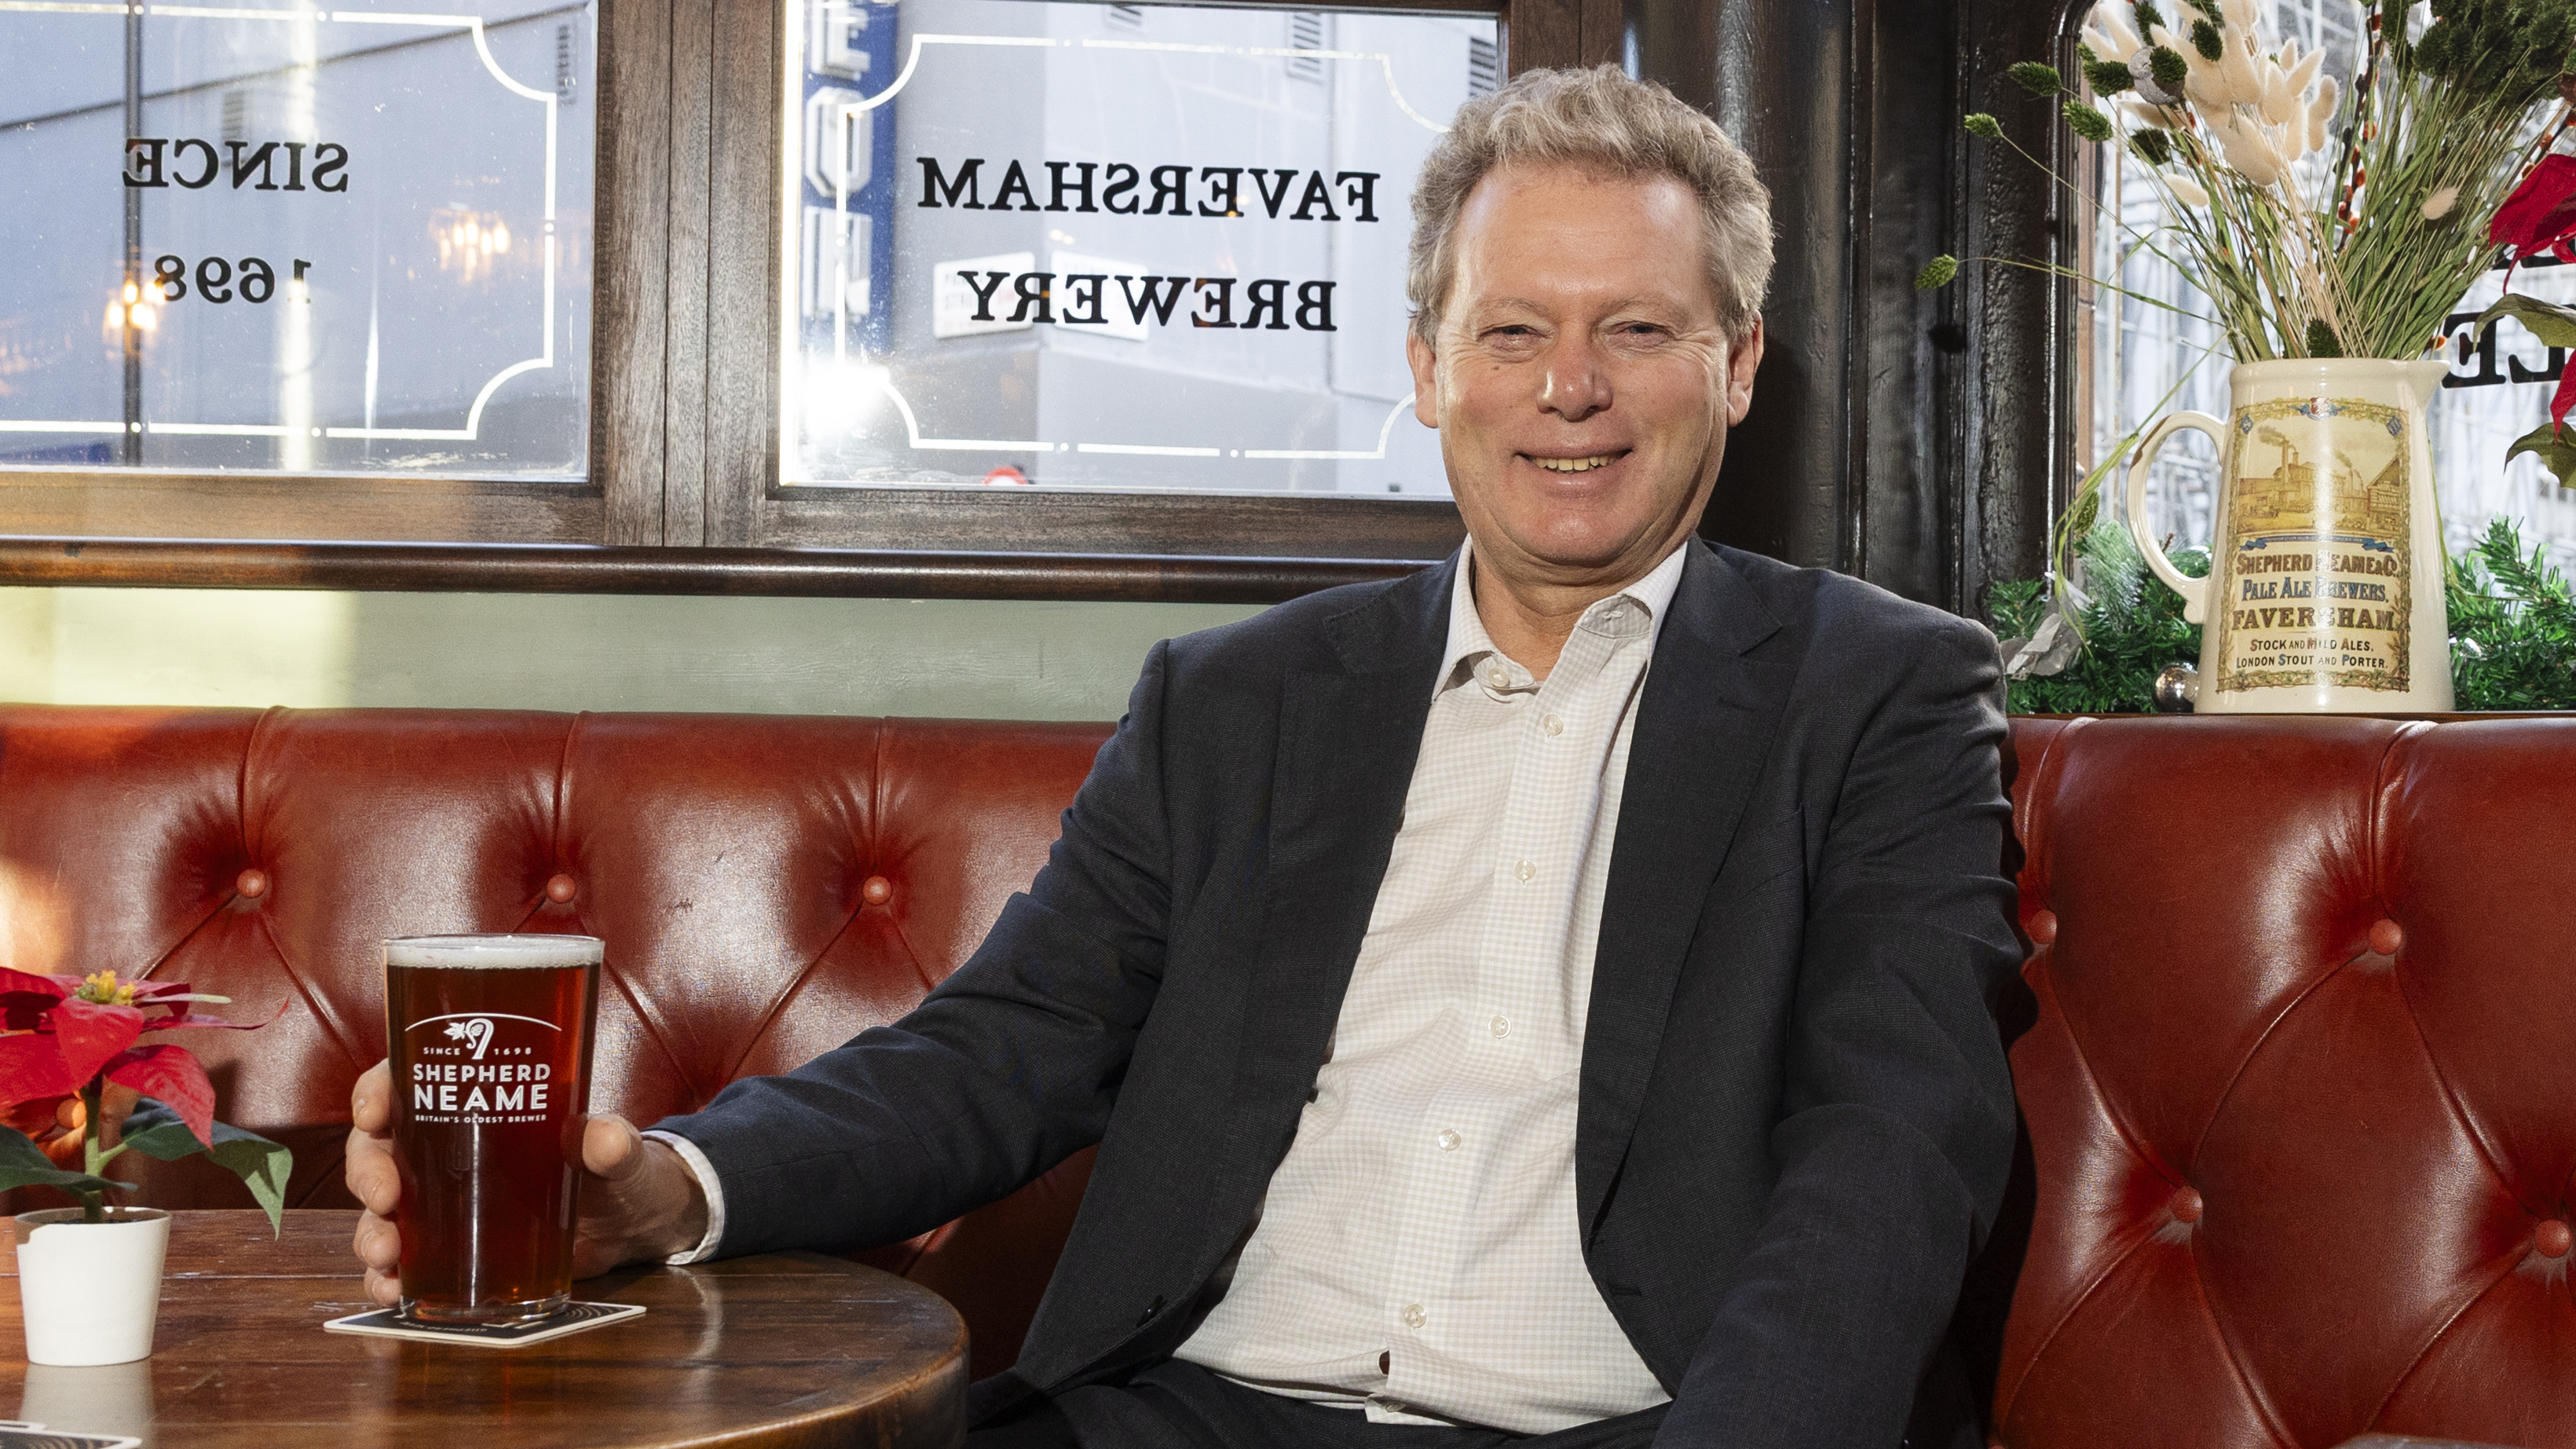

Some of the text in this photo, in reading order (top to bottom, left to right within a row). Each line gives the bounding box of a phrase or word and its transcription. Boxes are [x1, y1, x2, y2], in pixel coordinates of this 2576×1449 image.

[2237, 553, 2312, 575] SHEPHERD
[2241, 579, 2277, 601] PALE
[2280, 576, 2311, 598] ALE
[2250, 639, 2286, 651] STOCK
[2289, 641, 2305, 649] AND
[2237, 657, 2274, 668] LONDON
[2278, 654, 2313, 666] STOUT
[2318, 657, 2336, 665] AND
[423, 1047, 460, 1056] SINCE
[413, 1063, 551, 1082] SHEPHERD
[414, 1084, 548, 1111] NEAME
[415, 1114, 459, 1123] BRITAIN'S
[508, 1114, 547, 1123] BREWER
